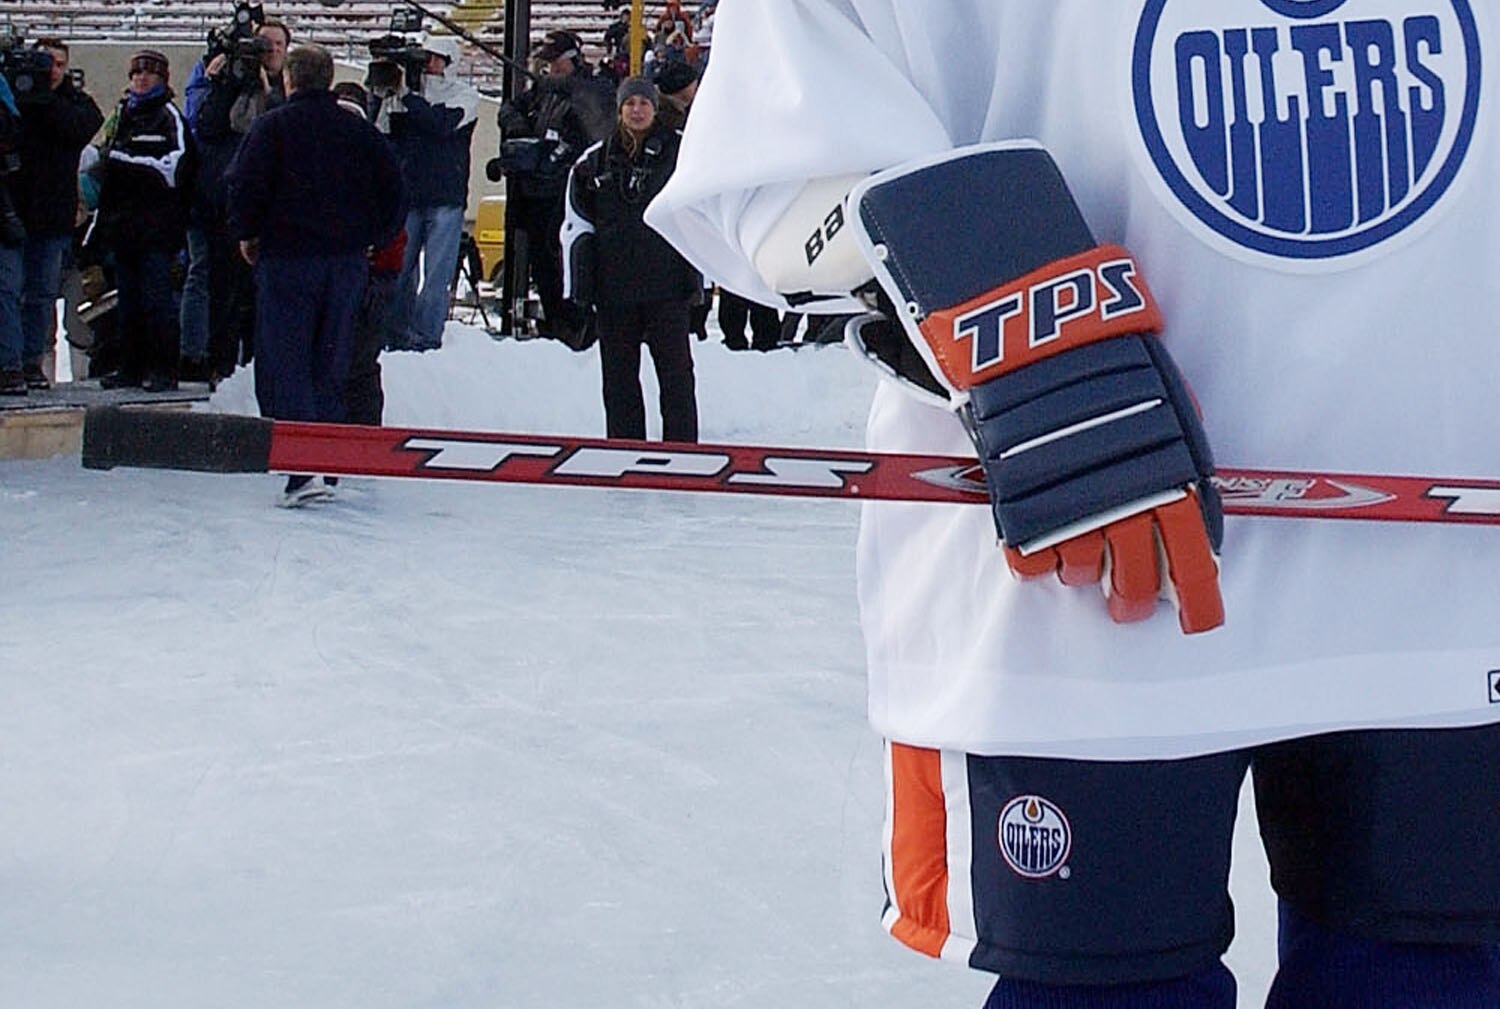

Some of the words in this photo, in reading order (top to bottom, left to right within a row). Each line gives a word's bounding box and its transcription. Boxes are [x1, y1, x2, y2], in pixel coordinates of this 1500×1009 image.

[1173, 14, 1447, 235] OILERS
[954, 258, 1144, 373] TPS
[402, 436, 874, 489] TPS
[1006, 822, 1061, 870] OILERS
